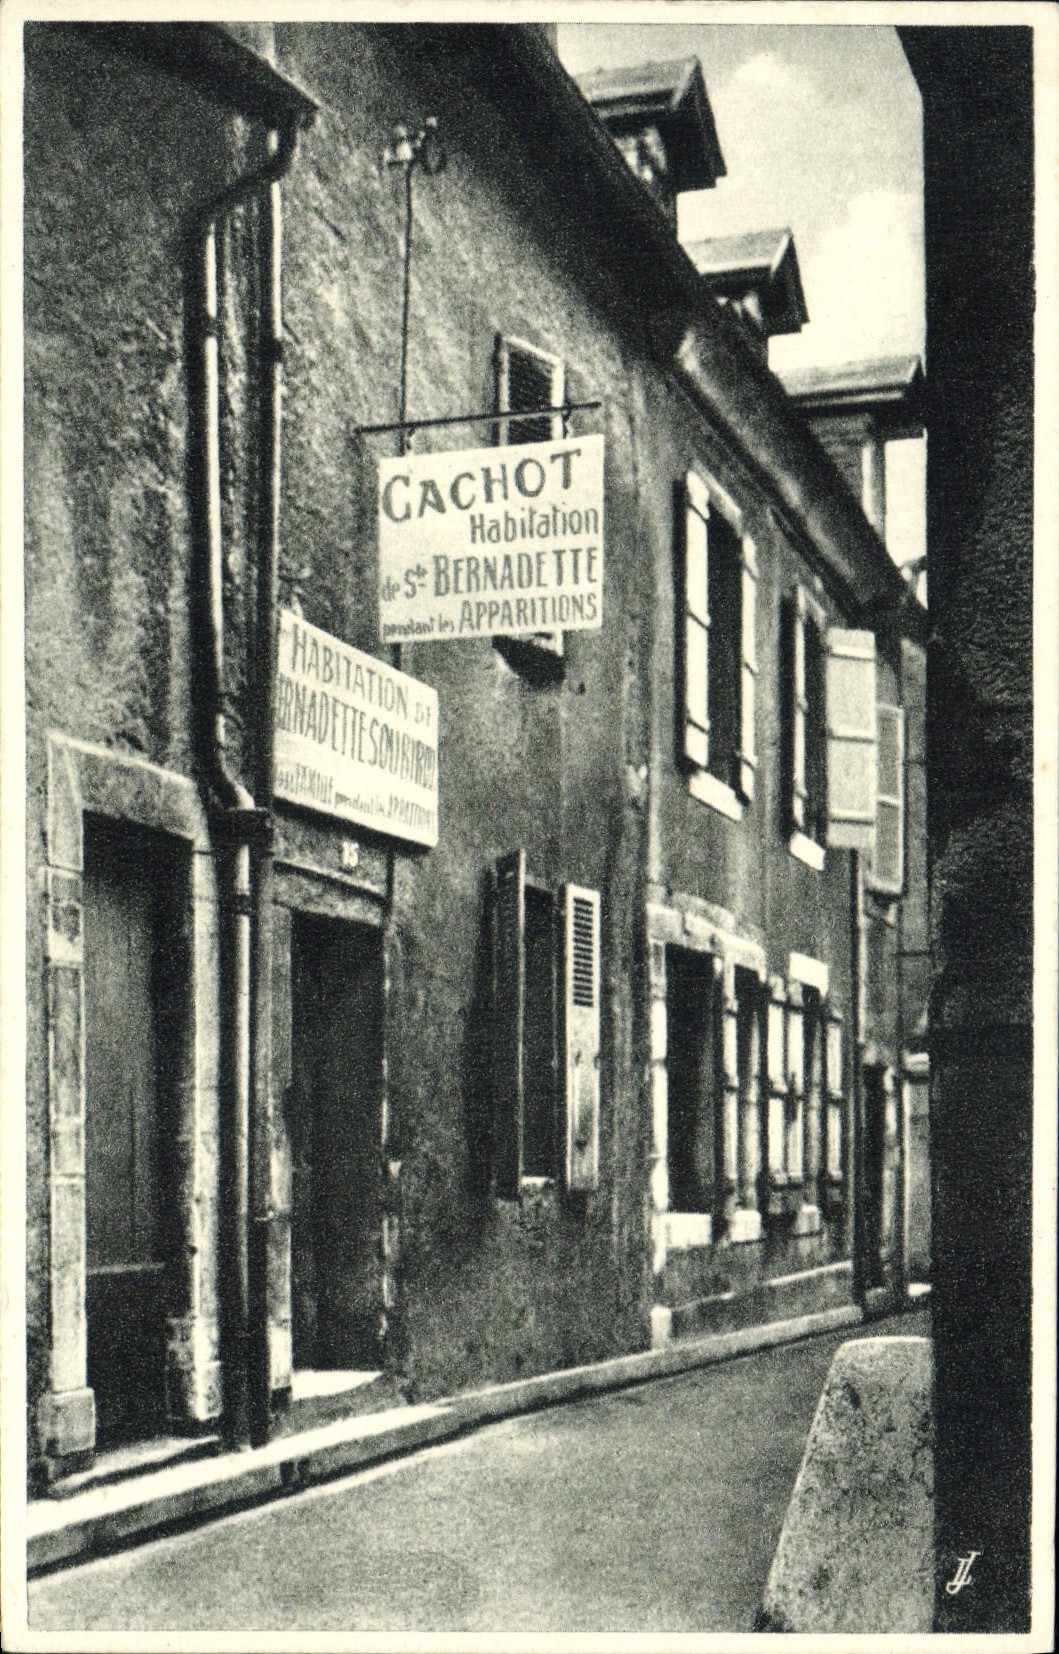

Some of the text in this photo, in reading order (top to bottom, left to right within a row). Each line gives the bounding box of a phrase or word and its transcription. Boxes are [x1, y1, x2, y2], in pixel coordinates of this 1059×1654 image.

[381, 448, 582, 523] CACHOT
[469, 501, 600, 544] Habitation
[381, 576, 401, 602] de
[432, 546, 598, 597] BERNADETTE
[458, 592, 598, 634] APPARITIONS
[291, 622, 409, 720] HABITATION
[274, 672, 367, 763] ERNADETTE
